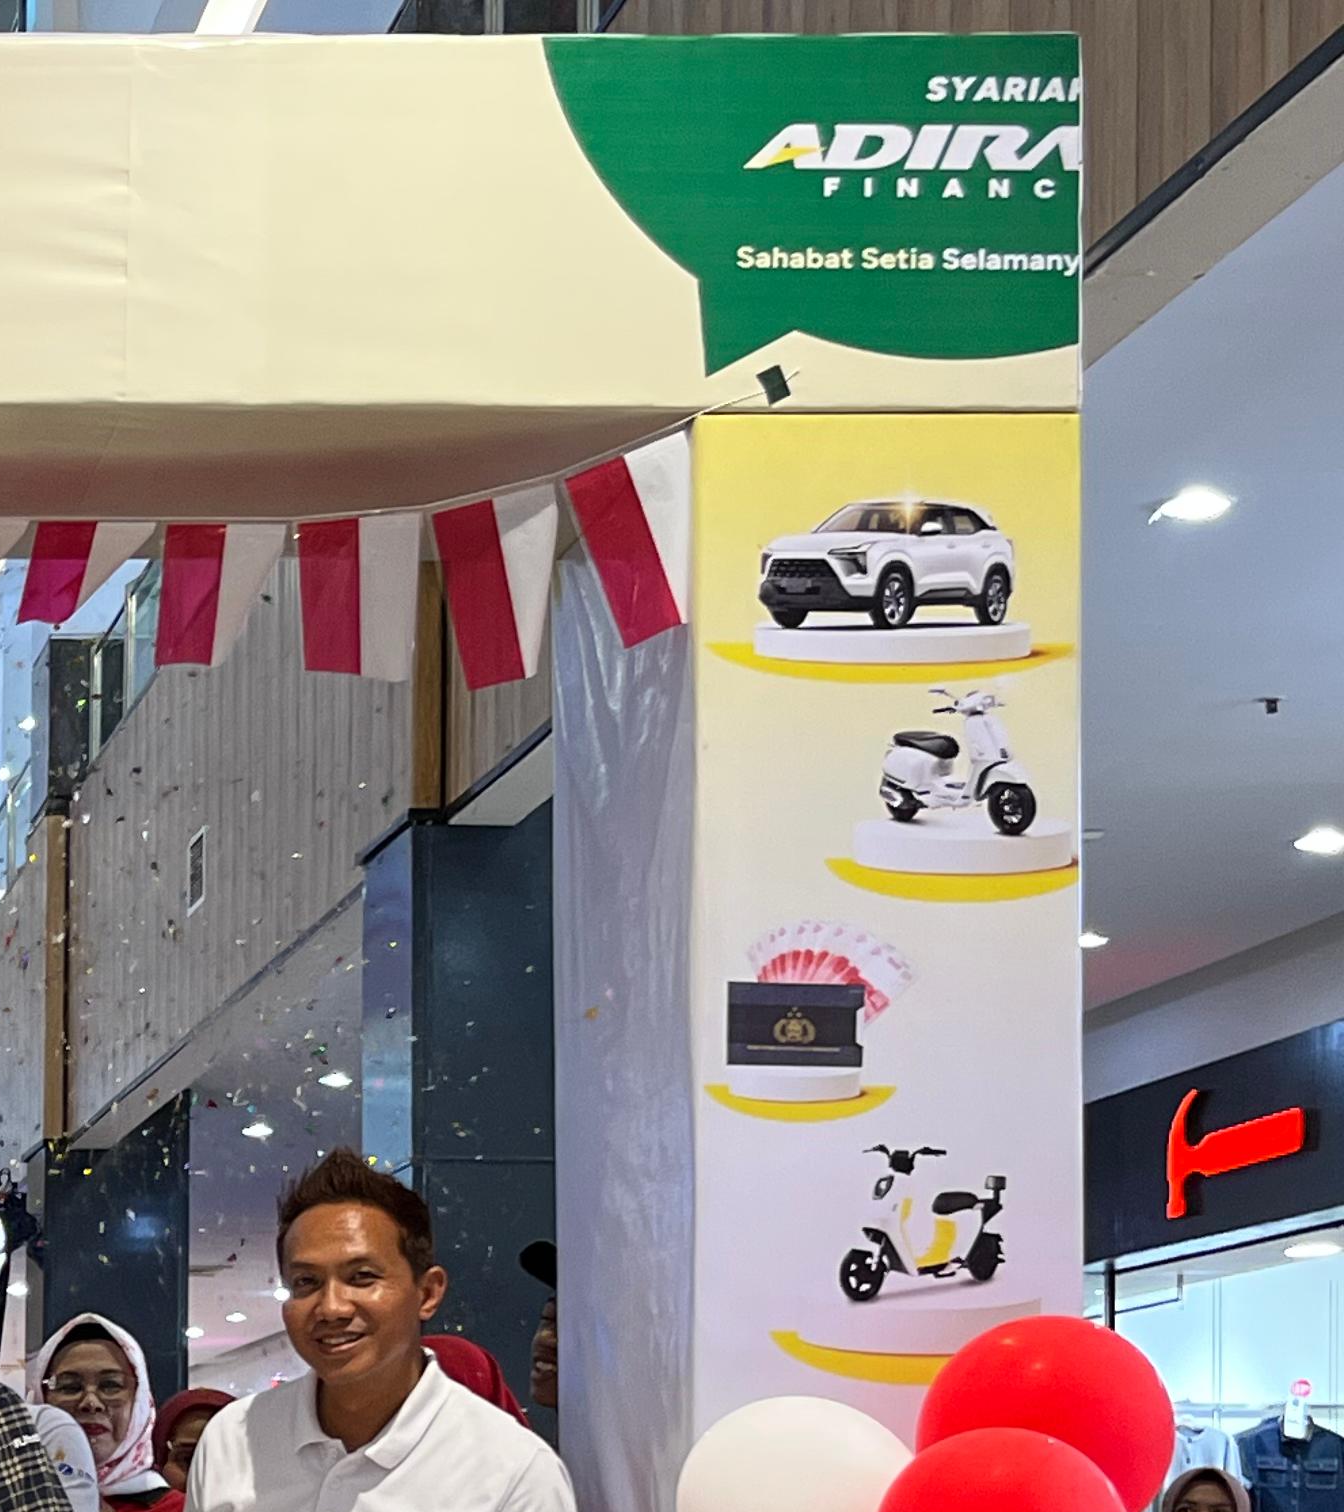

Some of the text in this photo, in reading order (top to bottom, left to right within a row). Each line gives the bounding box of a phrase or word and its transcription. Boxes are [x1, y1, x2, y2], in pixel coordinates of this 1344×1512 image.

[742, 123, 1080, 171] ADIRA
[736, 246, 853, 270] Sahabat
[862, 247, 934, 270] Setia
